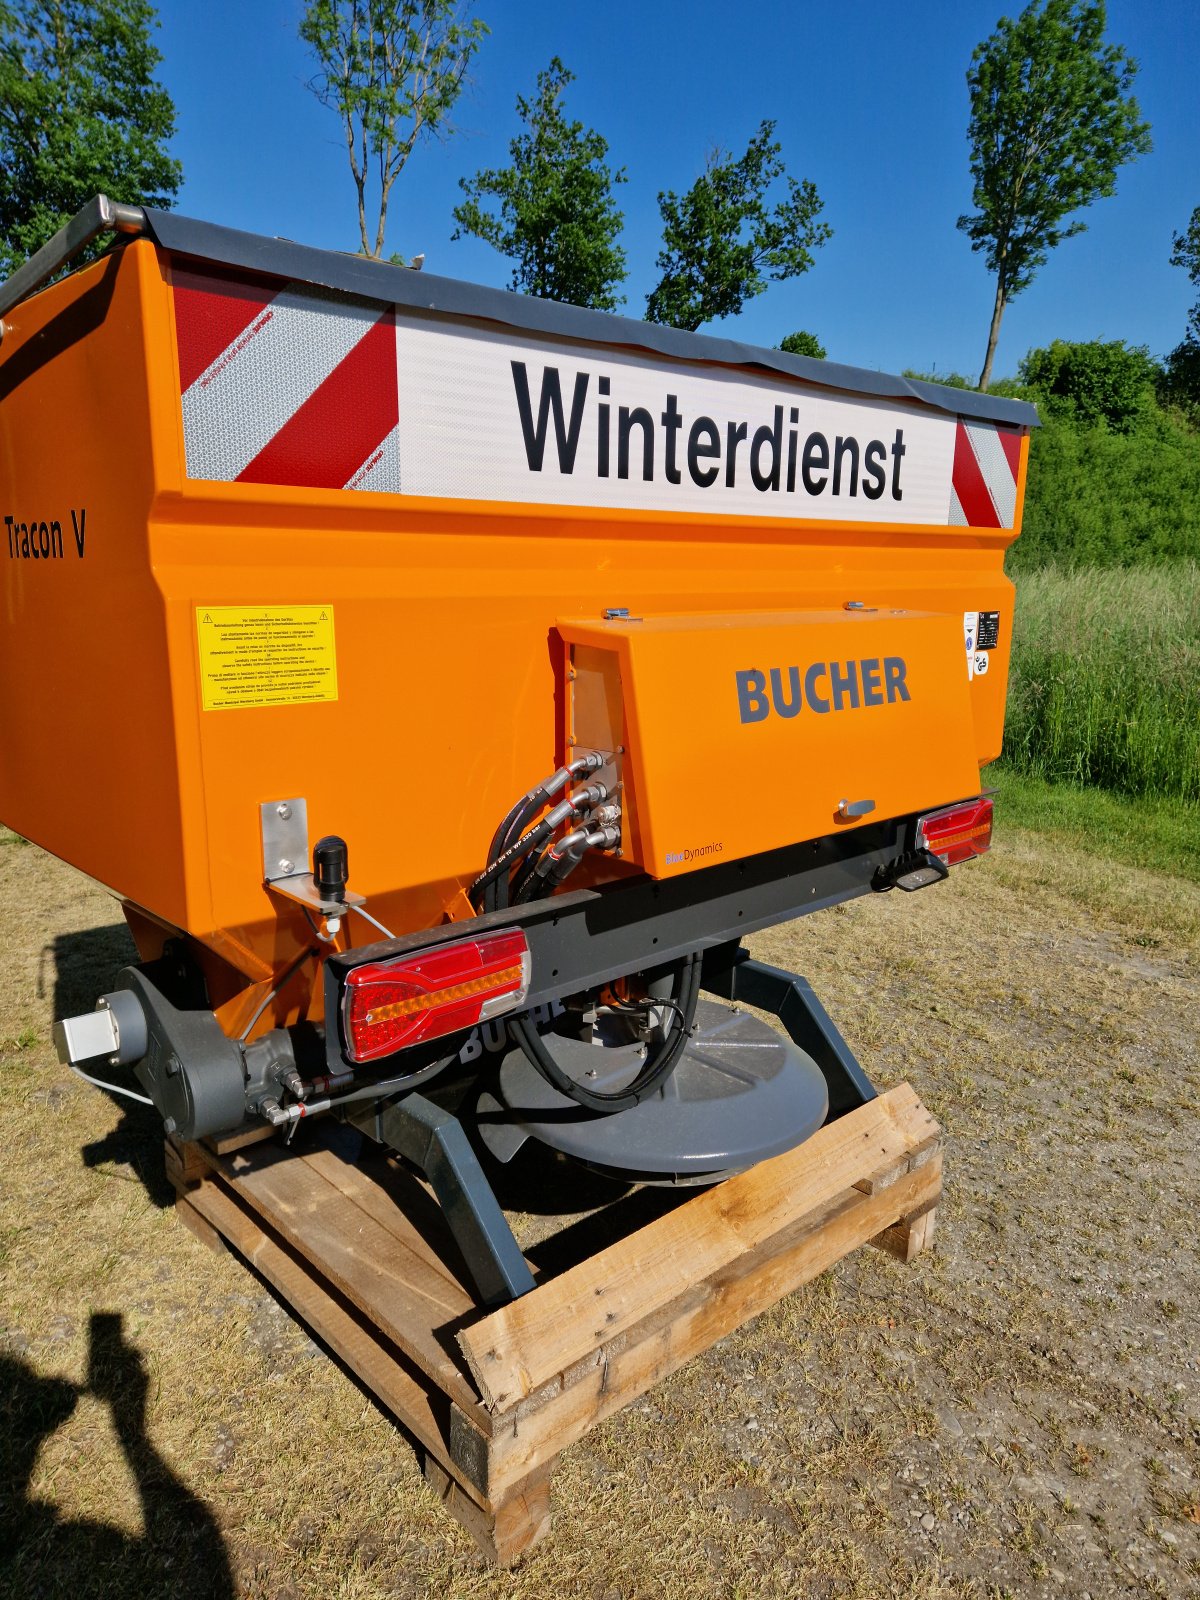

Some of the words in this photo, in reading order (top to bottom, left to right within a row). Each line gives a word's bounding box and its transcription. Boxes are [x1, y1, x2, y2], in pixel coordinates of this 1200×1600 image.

[511, 360, 906, 502] Winterdienst
[4, 515, 64, 559] Tracon
[70, 508, 86, 559] V
[735, 656, 912, 724] BUCHER
[512, 840, 522, 850] WP
[522, 832, 532, 842] 330
[665, 842, 723, 865] BlueDynamics
